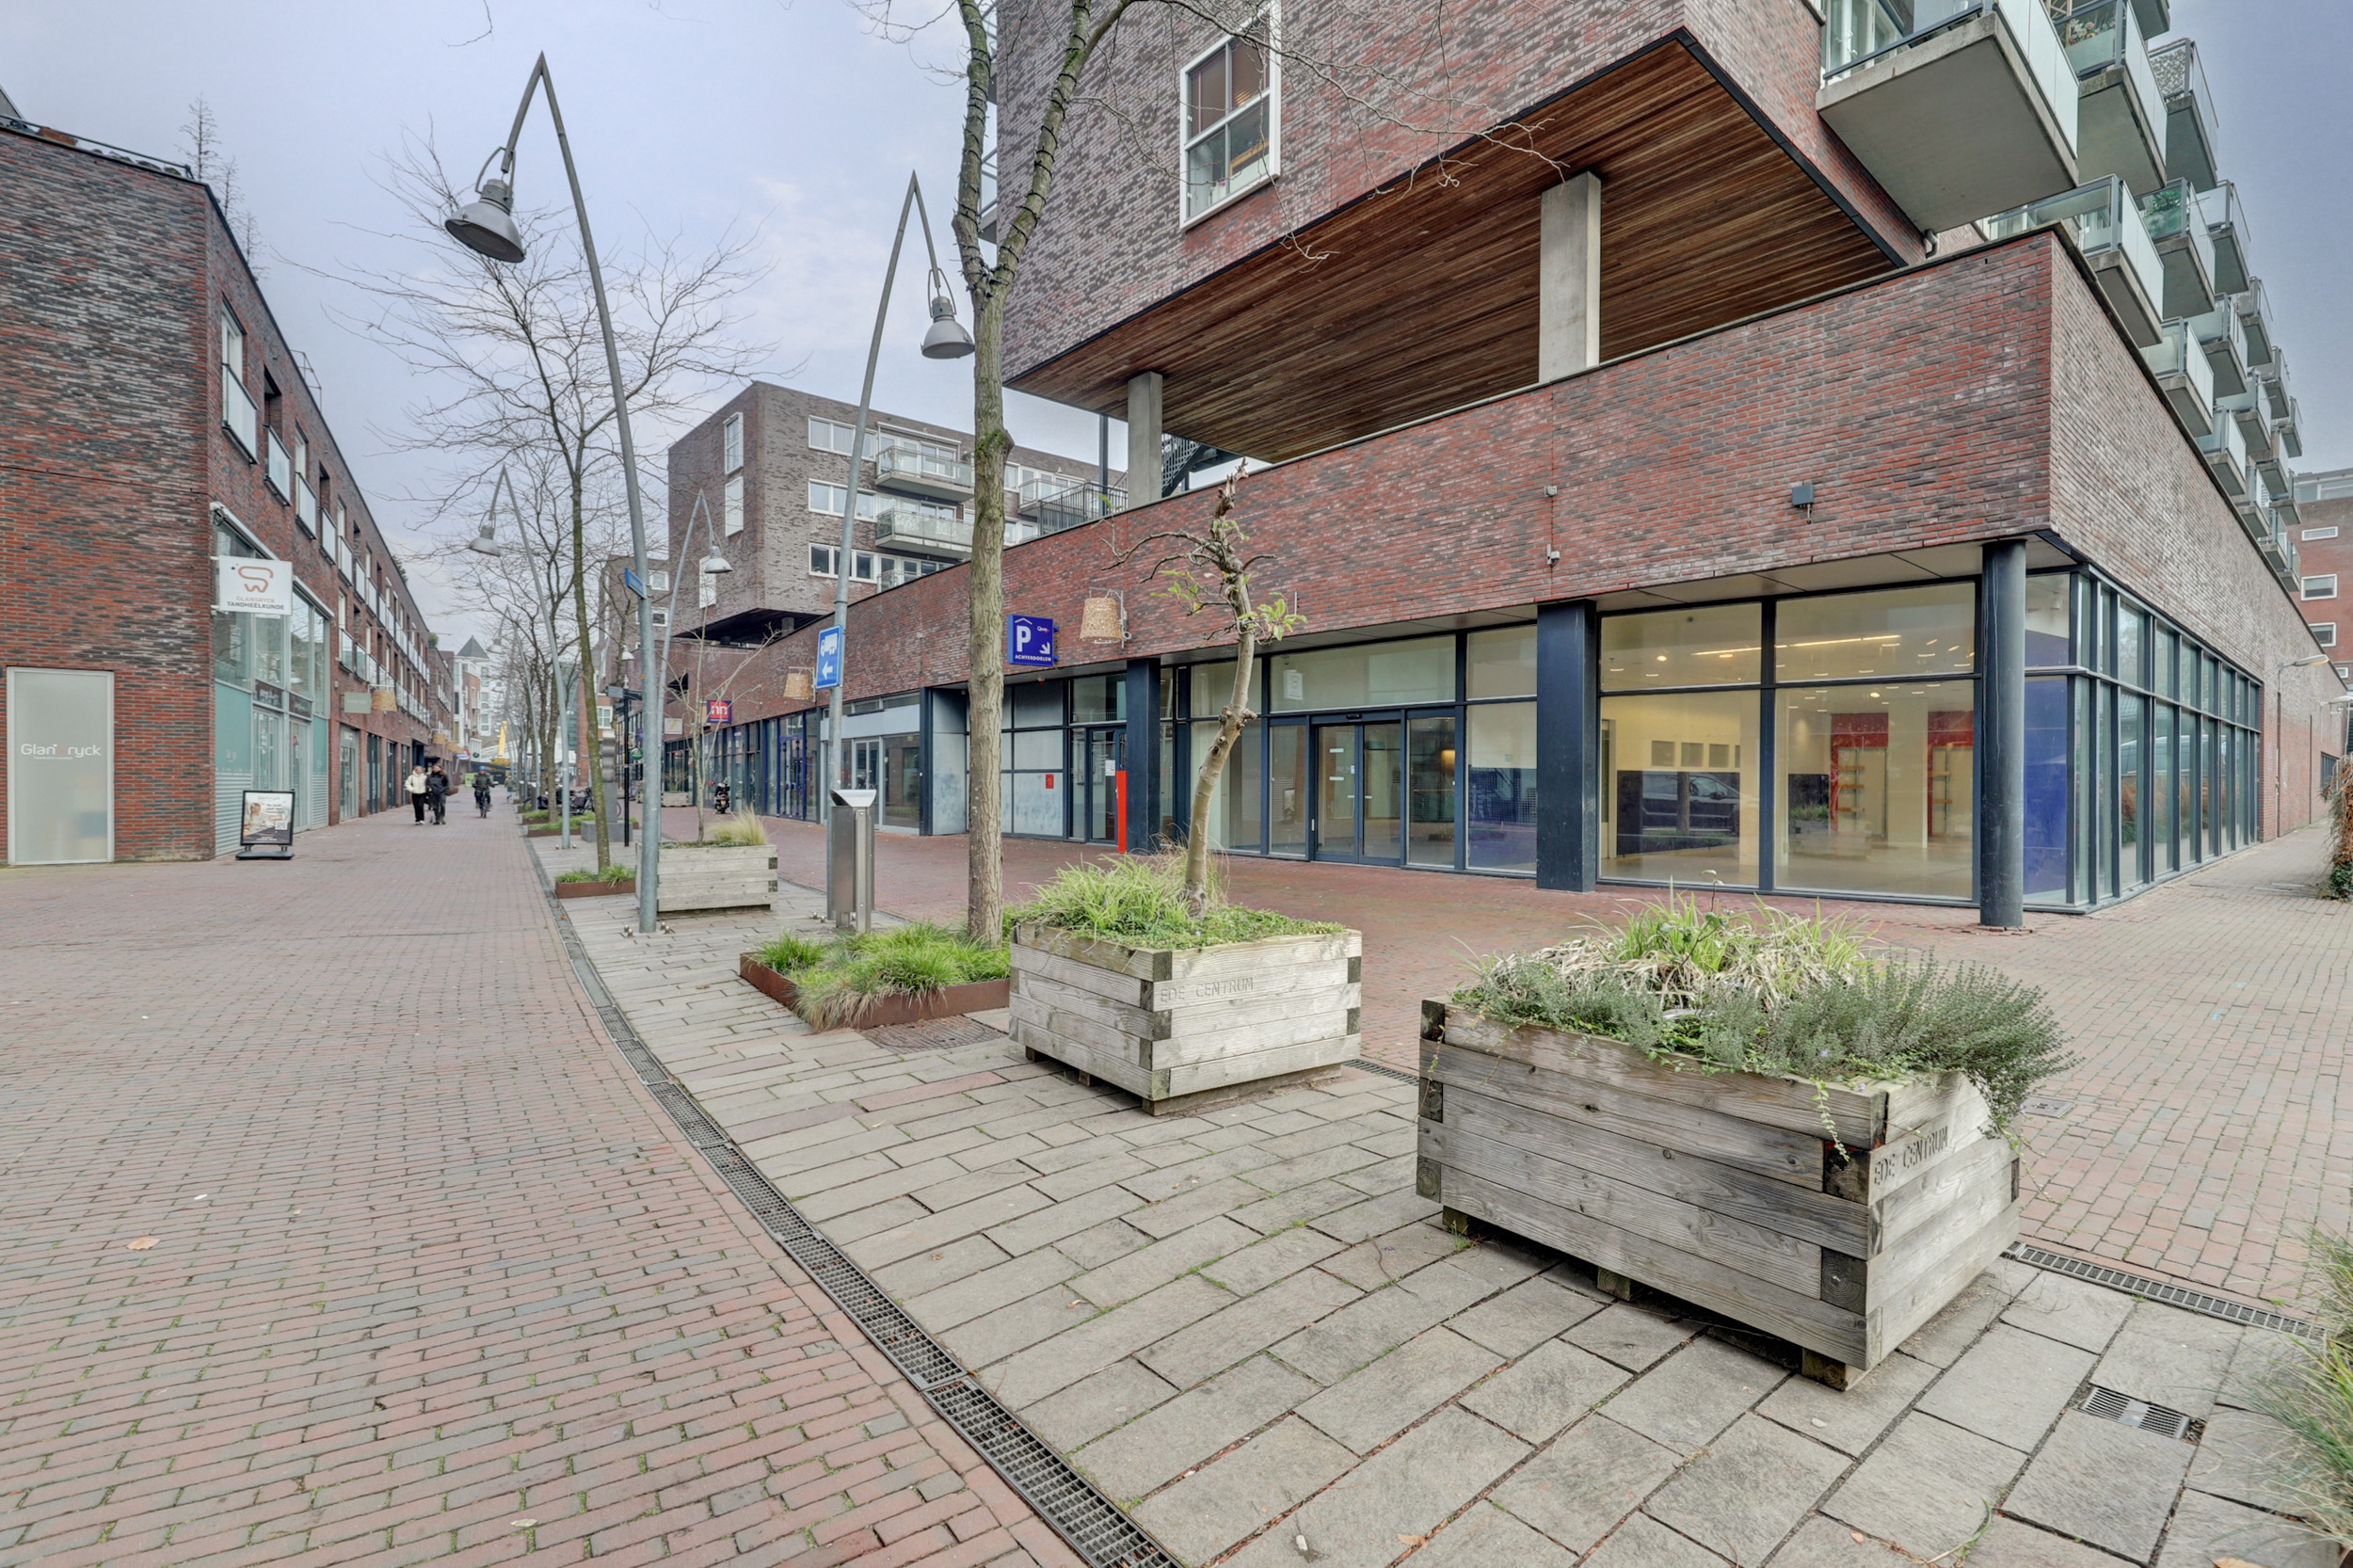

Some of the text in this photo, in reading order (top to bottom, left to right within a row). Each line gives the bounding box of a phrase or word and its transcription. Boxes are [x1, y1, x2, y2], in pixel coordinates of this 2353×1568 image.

[227, 601, 285, 610] TANDHEELKUNDE
[1016, 625, 1032, 652] P
[21, 744, 102, 758] Glanryck
[1160, 977, 1254, 1002] EDE CENTRUM
[1874, 1126, 1948, 1186] EDE CENTRUM
